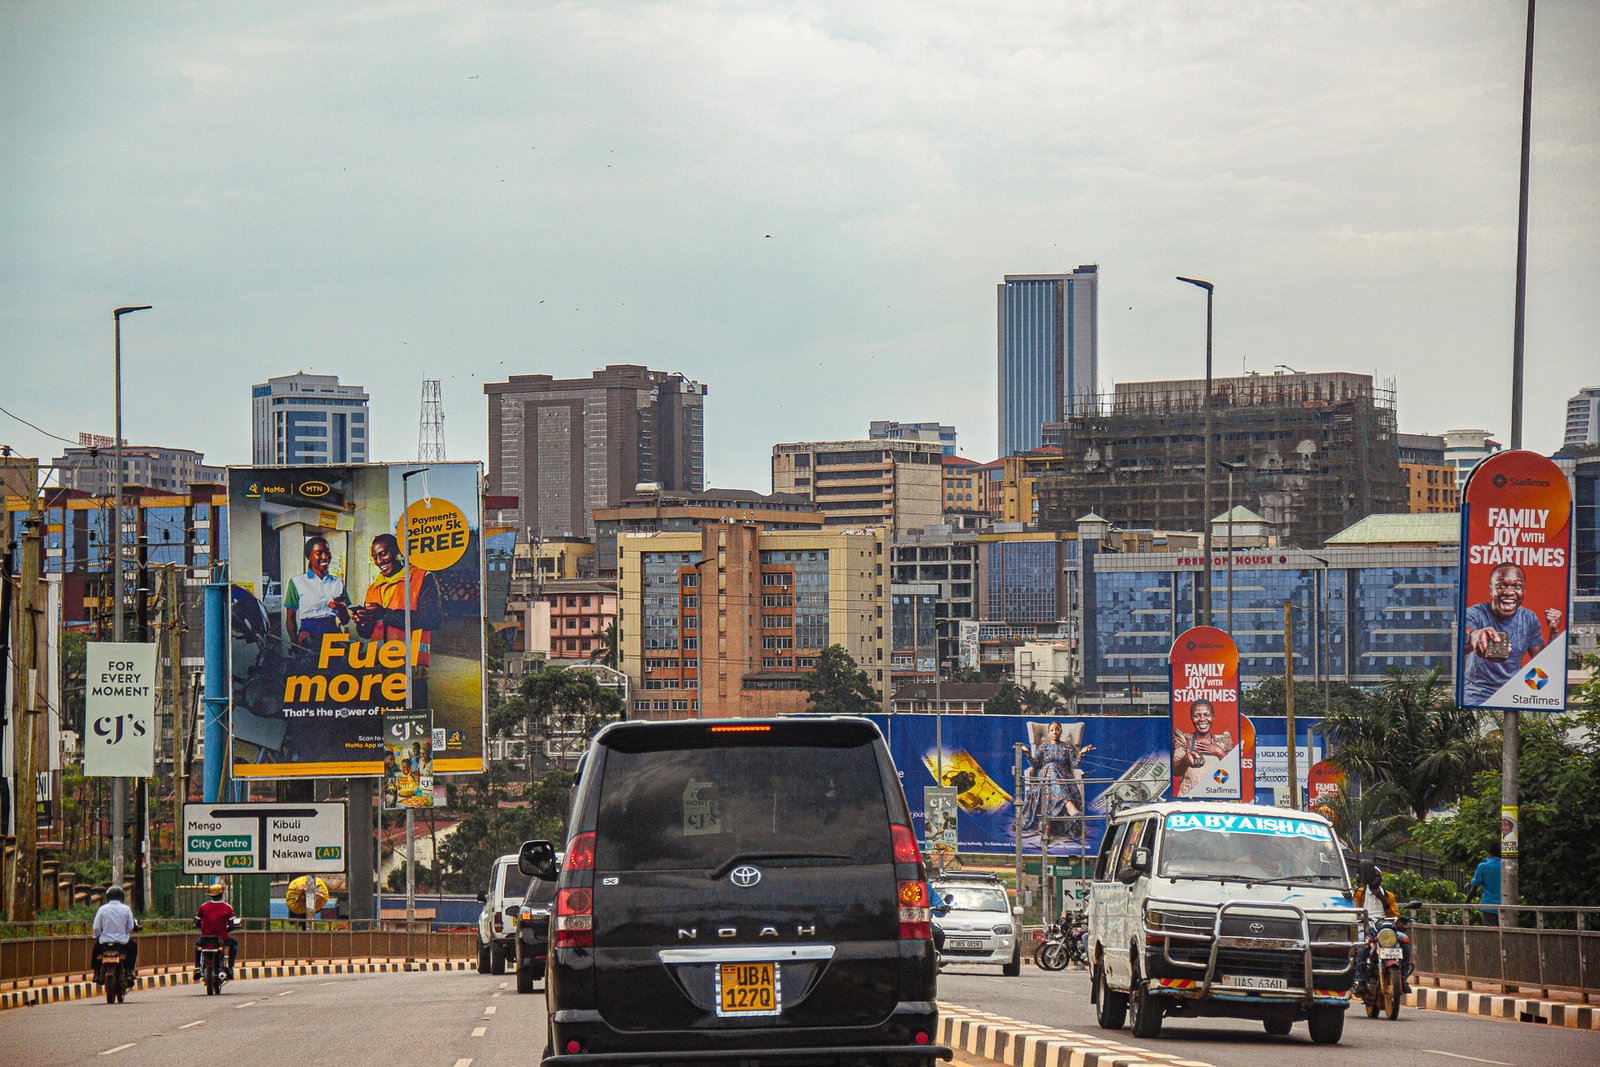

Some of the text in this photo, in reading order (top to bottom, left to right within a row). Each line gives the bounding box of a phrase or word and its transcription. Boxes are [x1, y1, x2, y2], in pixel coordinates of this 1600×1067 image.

[412, 511, 458, 525] Payments
[1488, 507, 1550, 528] FAMILY
[445, 520, 462, 530] 5k
[1488, 527, 1545, 546] JOY WITH
[408, 530, 465, 556] FREE
[1236, 555, 1273, 565] HOUSE
[1469, 545, 1565, 567] STARTIMES
[317, 628, 423, 669] Fuel
[108, 661, 134, 671] FOR
[1184, 663, 1225, 677] FAMILY
[101, 673, 141, 683] EVERY
[1185, 676, 1207, 689] JOY
[91, 686, 149, 696] MOMENT
[283, 672, 407, 703] more
[1174, 689, 1237, 702] STARTIMES
[1512, 694, 1560, 706] StarTimes
[282, 707, 315, 718] That's
[316, 707, 334, 717] the
[367, 707, 380, 716] of
[1205, 786, 1238, 794] StarTimes
[188, 821, 222, 832] Mengo
[272, 820, 301, 829] Kibuli
[190, 839, 248, 849] City Centre
[272, 833, 310, 844] Mulago
[272, 847, 341, 859] Nakawa (A1)
[187, 856, 253, 868] Kibuye (A3)
[678, 925, 815, 939] NOAH
[736, 966, 772, 986] UBA
[1234, 977, 1254, 988] UAS
[726, 987, 772, 1008] 127Q
